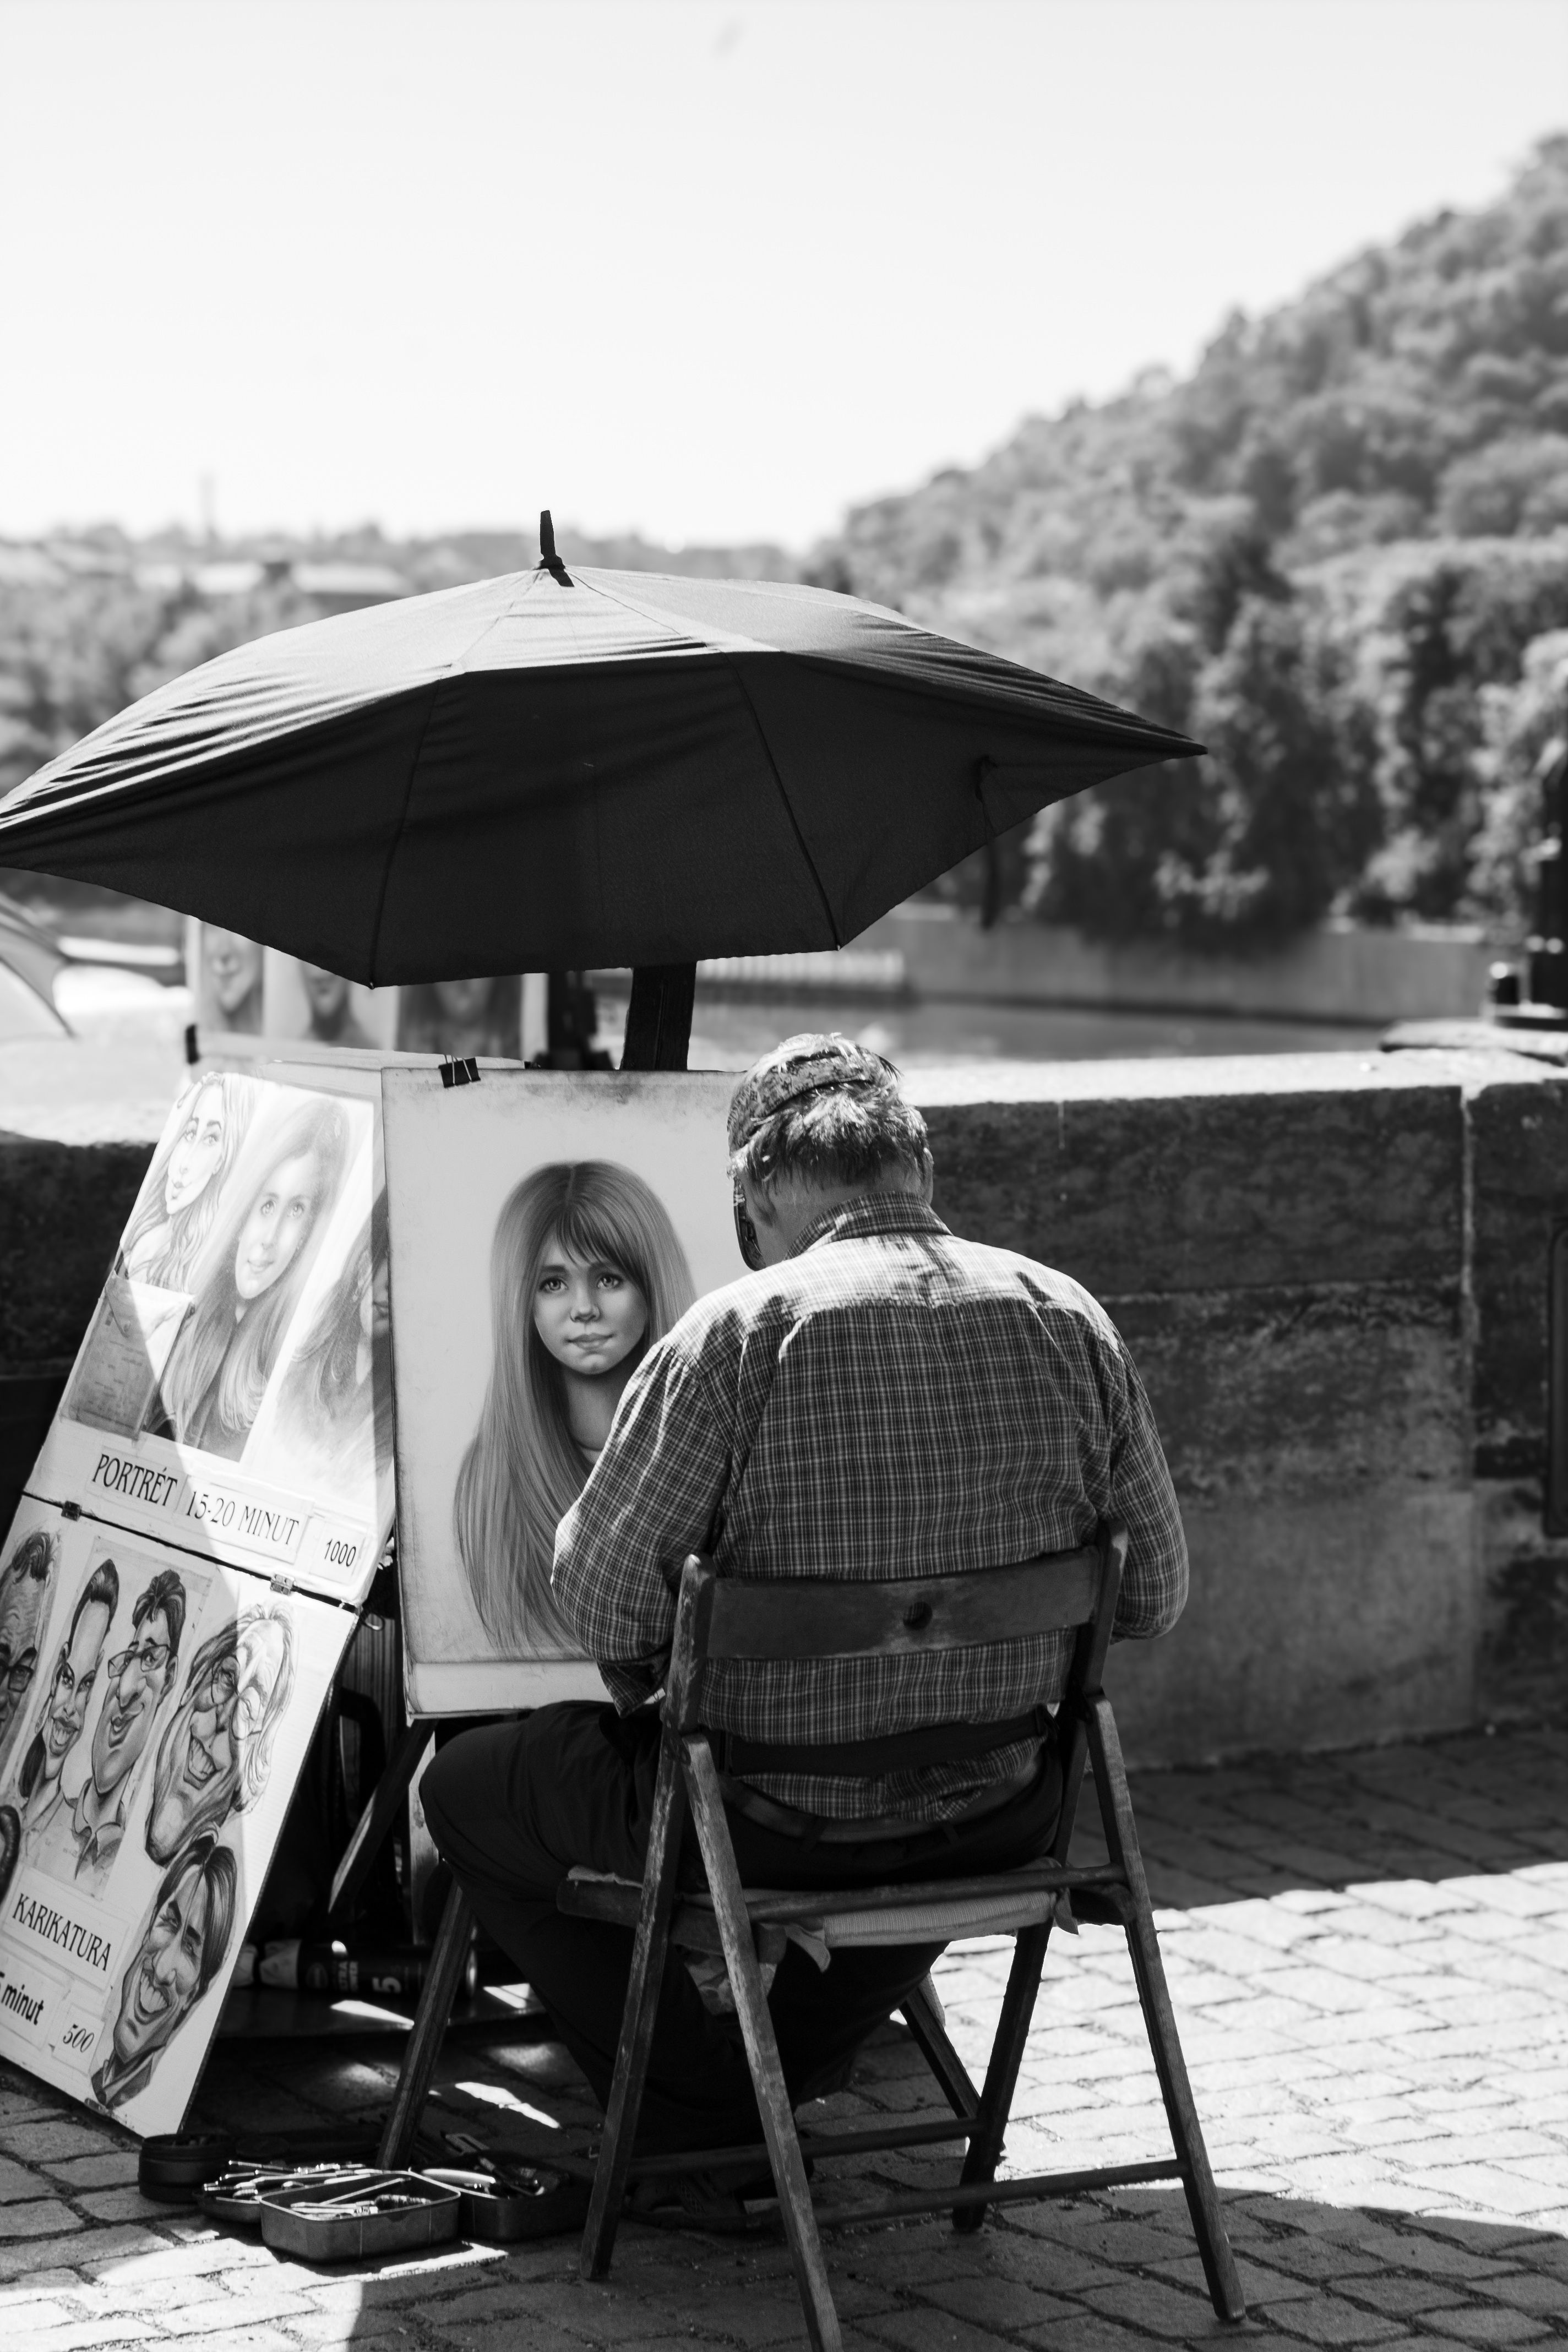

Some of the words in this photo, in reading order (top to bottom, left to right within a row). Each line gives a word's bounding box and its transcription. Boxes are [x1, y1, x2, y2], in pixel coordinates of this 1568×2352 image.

[92, 1453, 178, 1506] PORTRÉT
[186, 1491, 236, 1527] 15-20
[238, 1506, 300, 1545] MINUT
[324, 1538, 357, 1567] 1000
[12, 1893, 111, 1972] KARIKATURA
[1, 1984, 44, 2026] minut
[63, 2023, 95, 2053] 500
[372, 1975, 402, 1994] 5
